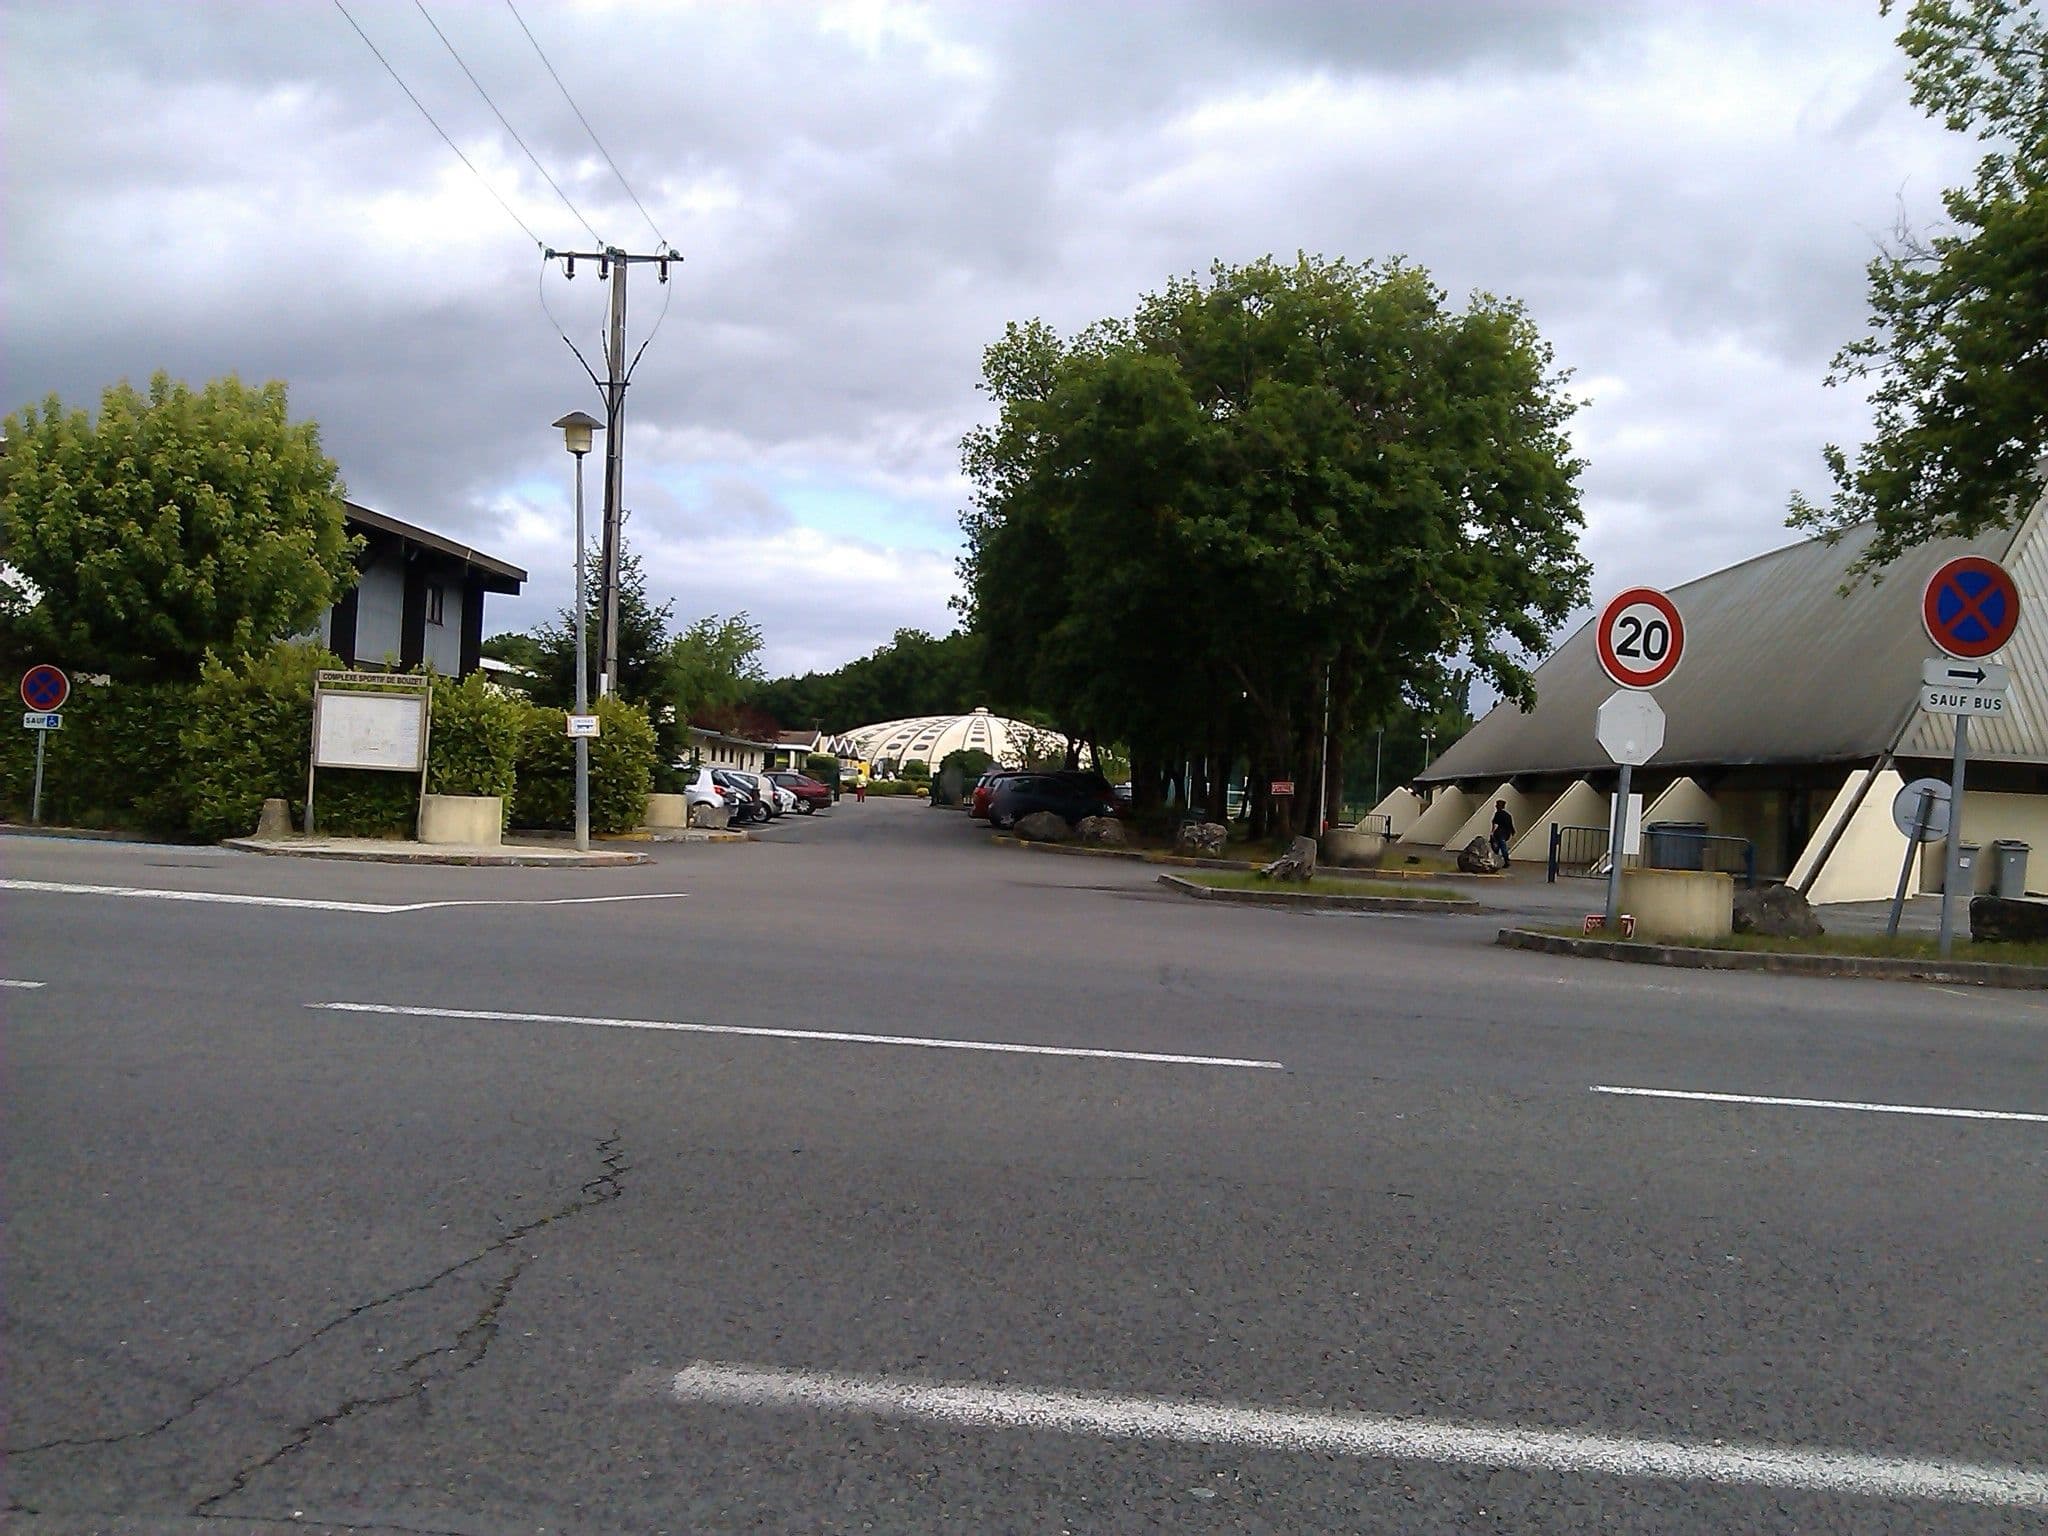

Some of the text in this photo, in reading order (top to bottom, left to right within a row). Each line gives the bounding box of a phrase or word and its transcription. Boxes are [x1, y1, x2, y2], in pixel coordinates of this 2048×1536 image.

[1616, 616, 1669, 661] 20
[323, 673, 358, 682] COMPLEXE
[359, 674, 386, 684] SPORTIF
[386, 676, 396, 684] DE
[1930, 693, 2002, 710] SAUF BUS
